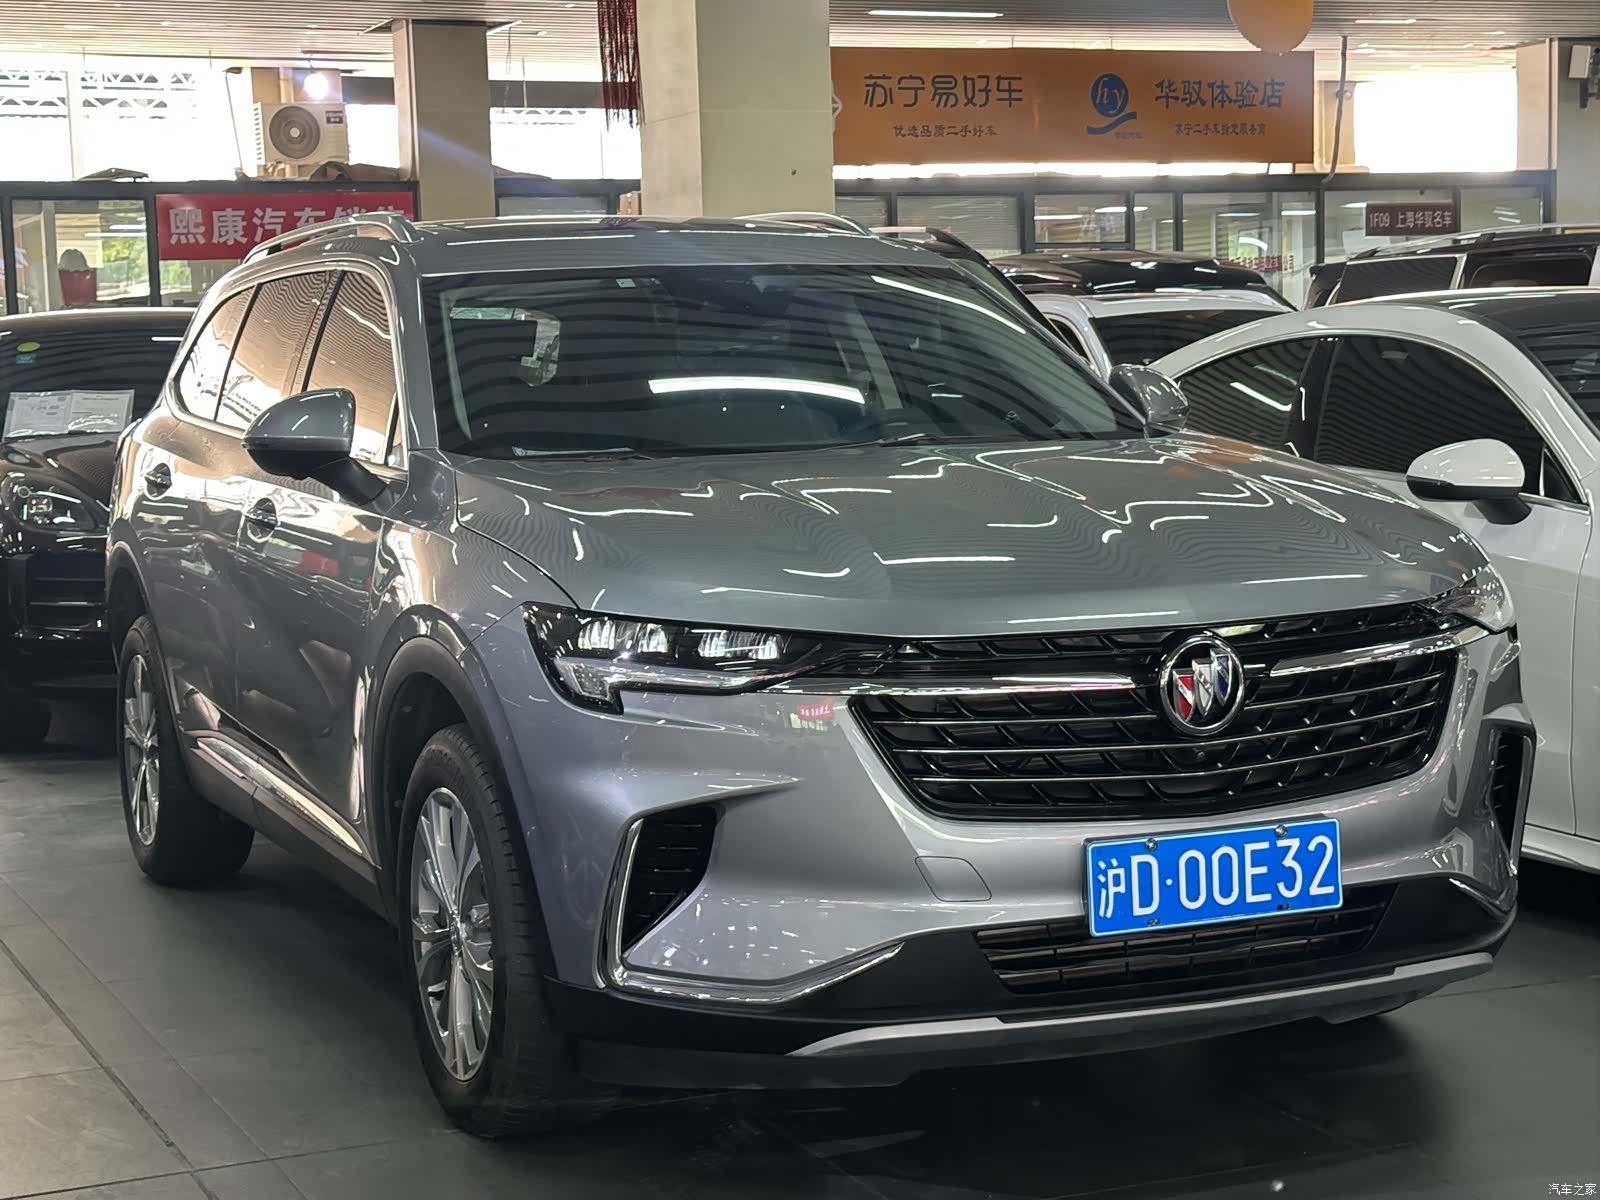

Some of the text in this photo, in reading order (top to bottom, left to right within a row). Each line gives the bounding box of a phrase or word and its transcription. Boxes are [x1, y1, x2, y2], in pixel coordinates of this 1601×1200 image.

[863, 74, 1024, 108] 苏宁易好车
[1154, 77, 1286, 109] 华驭体验店
[1369, 212, 1391, 228] 1F09
